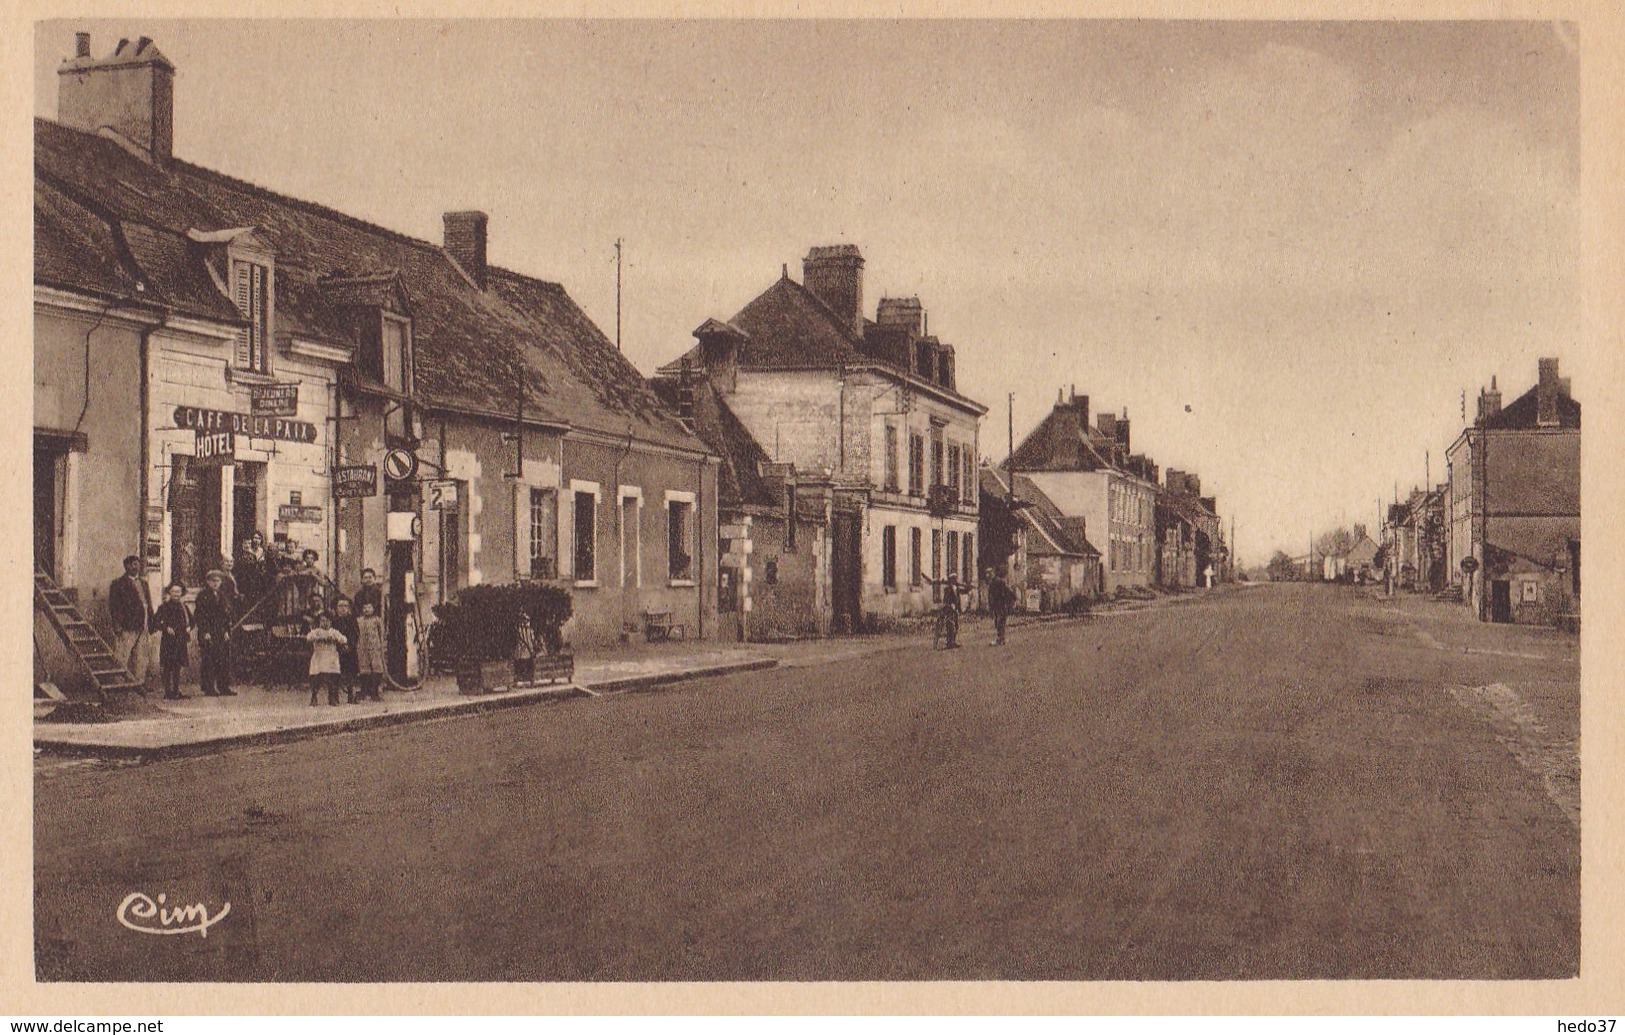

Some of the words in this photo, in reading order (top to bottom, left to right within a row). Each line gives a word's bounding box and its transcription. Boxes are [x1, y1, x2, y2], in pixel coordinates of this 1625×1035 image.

[232, 415, 249, 433] DE
[254, 417, 270, 436] LA
[276, 420, 307, 440] PAIX
[196, 431, 233, 459] HÔTEL
